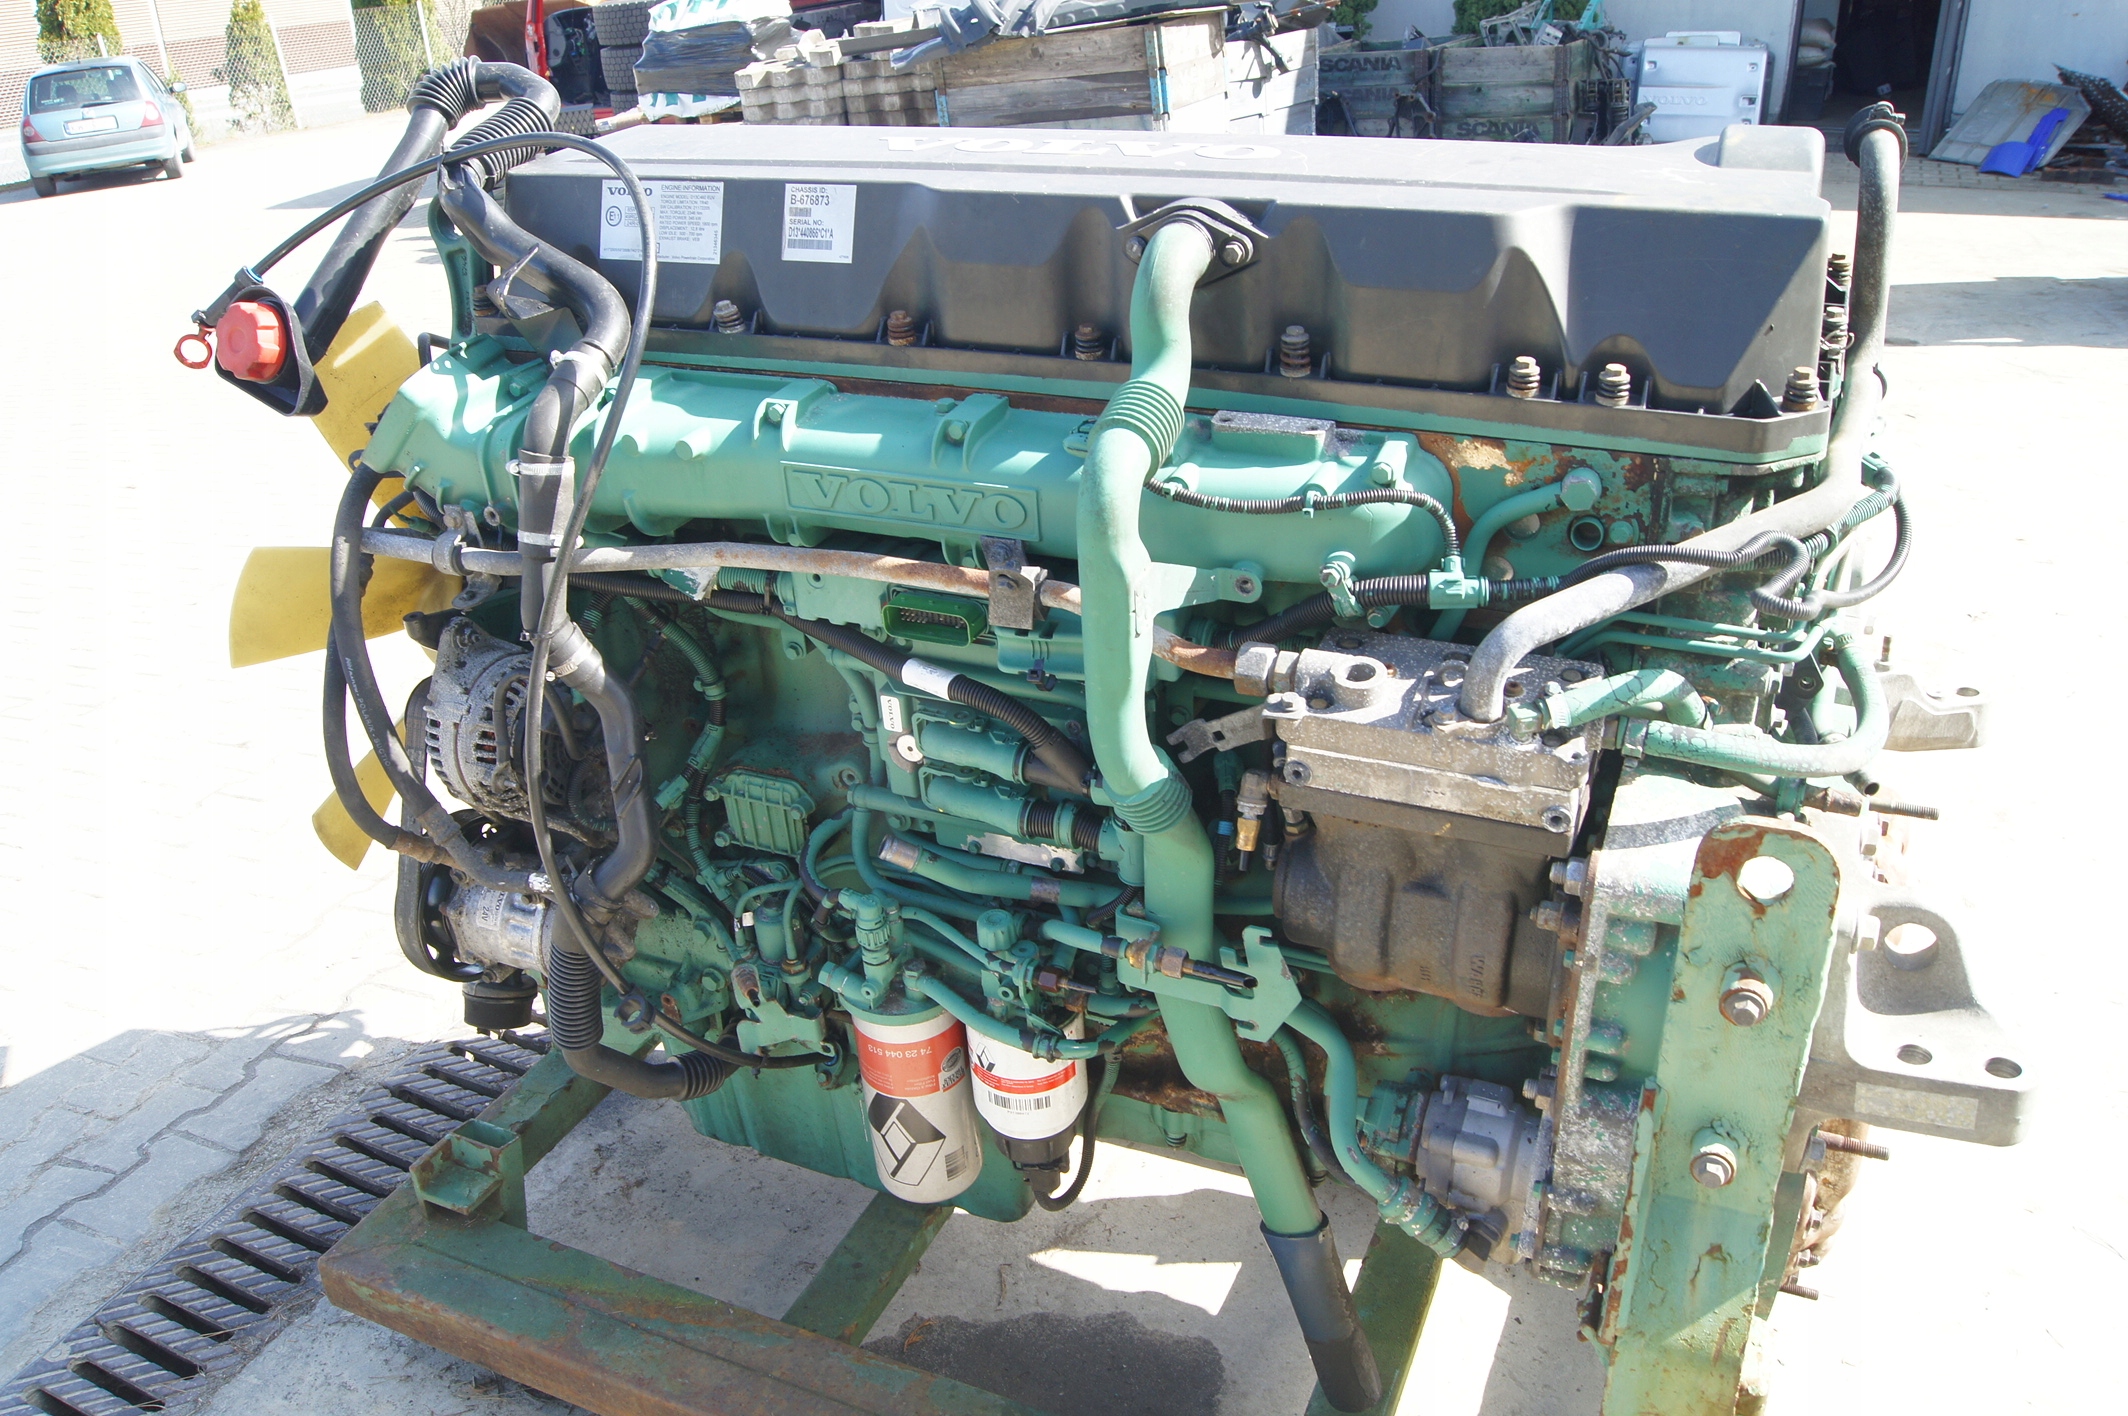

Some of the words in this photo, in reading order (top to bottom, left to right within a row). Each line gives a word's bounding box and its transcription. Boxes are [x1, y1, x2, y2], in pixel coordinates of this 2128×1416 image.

[1319, 56, 1402, 73] SCANIA
[1643, 94, 1708, 106] VOLVO
[879, 136, 1282, 160] VOLVO
[607, 187, 653, 197] VOO
[790, 186, 818, 194] CHASSIS
[790, 193, 830, 206] B-676873
[792, 469, 1028, 530] VOLVO
[886, 698, 896, 730] VOLVO
[481, 906, 490, 922] 24V
[867, 1044, 883, 1056] 513
[885, 1049, 903, 1058] 044
[904, 1049, 918, 1058] 23
[920, 1045, 933, 1056] 74
